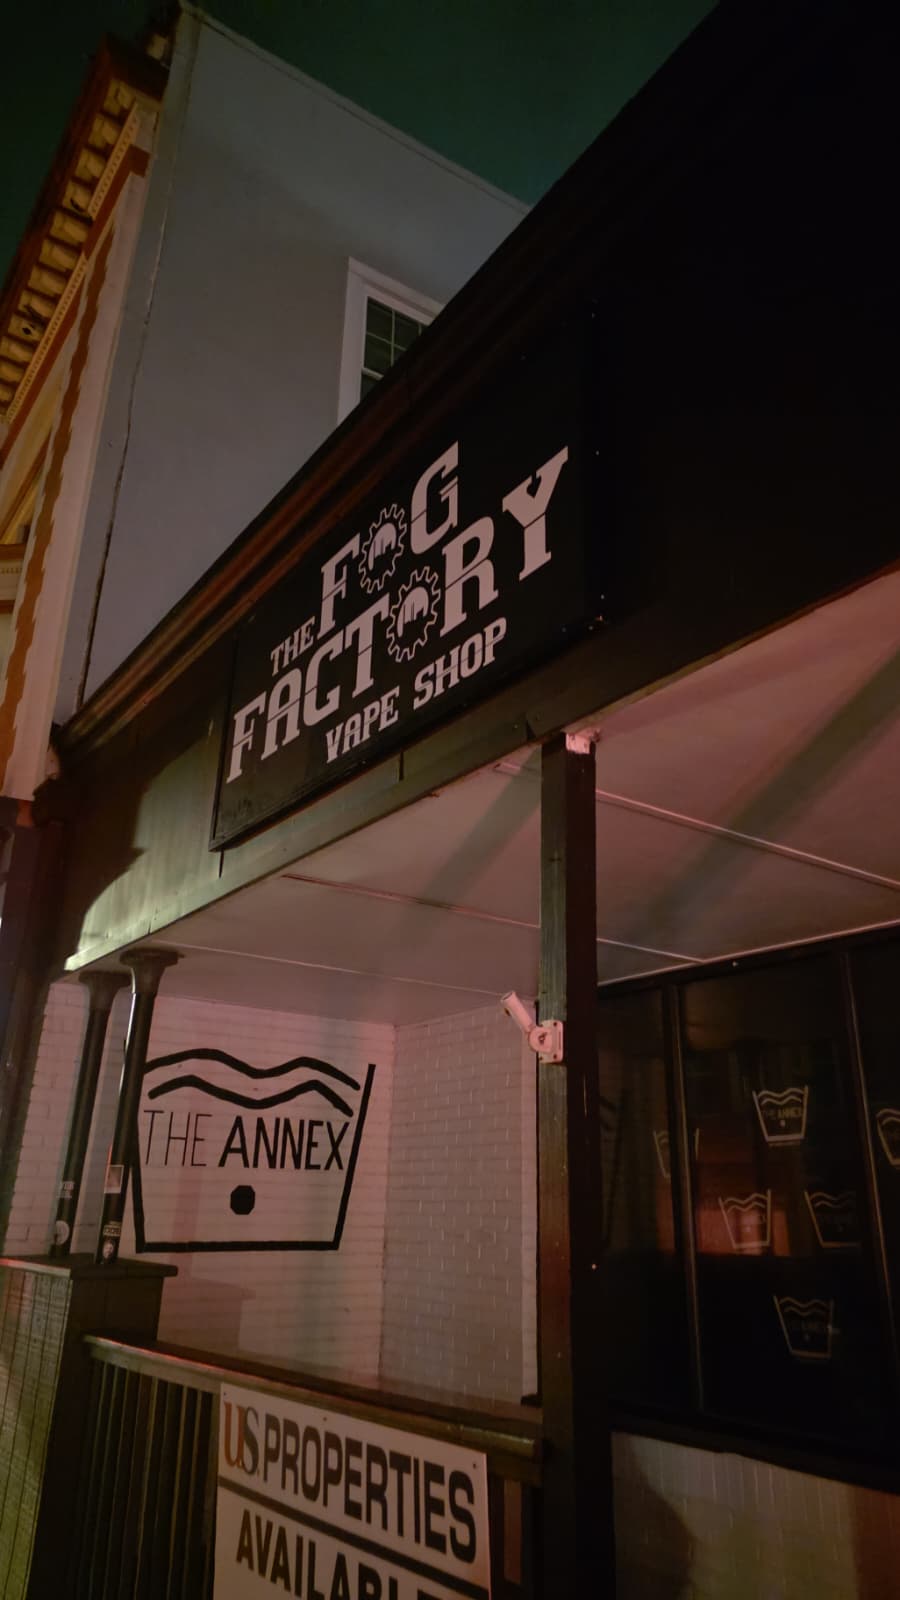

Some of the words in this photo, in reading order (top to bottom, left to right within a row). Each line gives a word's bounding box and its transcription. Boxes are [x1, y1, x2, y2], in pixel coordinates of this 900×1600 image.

[226, 445, 569, 784] FACTORY
[270, 615, 316, 678] THE
[316, 440, 460, 641] FOG
[325, 685, 400, 764] VAPE
[413, 617, 508, 711] SHOP
[143, 1110, 213, 1167] THE
[218, 1115, 350, 1170] ANNEX
[236, 1508, 443, 1600] AVAILAB
[263, 1413, 477, 1564] PROPERTIES
